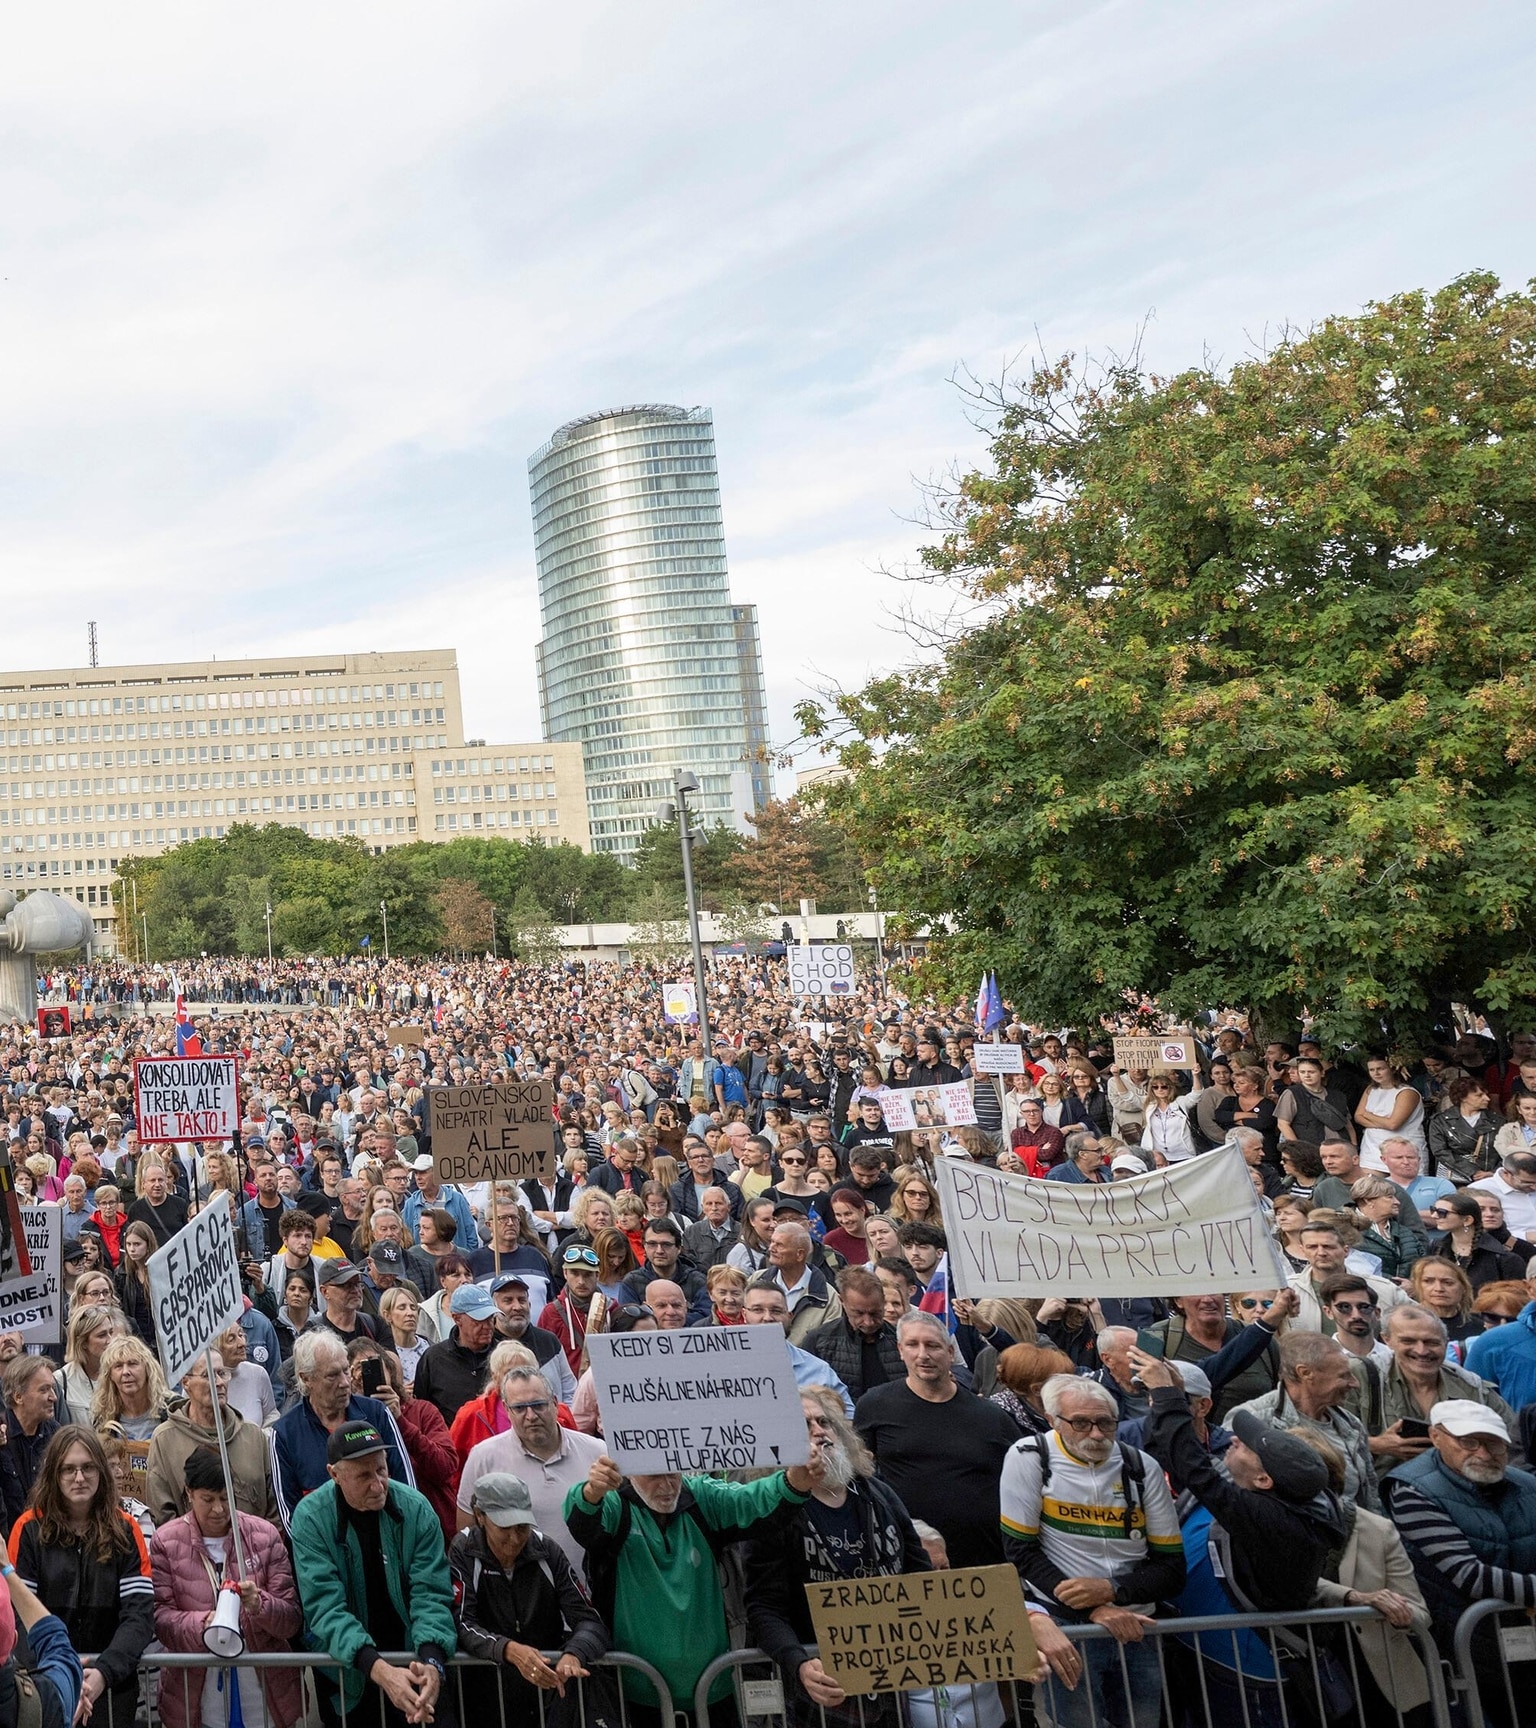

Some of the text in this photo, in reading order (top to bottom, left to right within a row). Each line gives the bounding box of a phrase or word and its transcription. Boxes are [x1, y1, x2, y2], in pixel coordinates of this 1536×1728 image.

[792, 947, 851, 962] FICO
[793, 979, 823, 994] DO
[1116, 1040, 1133, 1048] STOP
[1117, 1051, 1134, 1059] STOP
[138, 1059, 233, 1089] KONSOLIDOVAŤ
[143, 1087, 221, 1115] TREBA, ALE
[435, 1085, 542, 1109] SLOVENSKO
[144, 1114, 169, 1138] NIE
[436, 1107, 494, 1130] NEPATRÍ
[467, 1128, 520, 1153] ALE
[439, 1151, 547, 1180] OBČANOM!
[963, 1228, 1092, 1283] VLÁDA
[160, 1237, 234, 1336] GAŠPAROVCI
[167, 1273, 236, 1373] ZLOČINCI
[610, 1328, 751, 1357] KEDY SI ZDANÍTE
[613, 1419, 756, 1451] NEROBTE Z NÁS
[664, 1445, 756, 1472] HLUPÁKOV
[1058, 1505, 1092, 1520] DEN
[820, 1576, 986, 1608] ZRADCA FICO
[828, 1608, 995, 1646] PUTINOVSKÁ
[831, 1631, 1016, 1672] PROTISLOVENSKÁ
